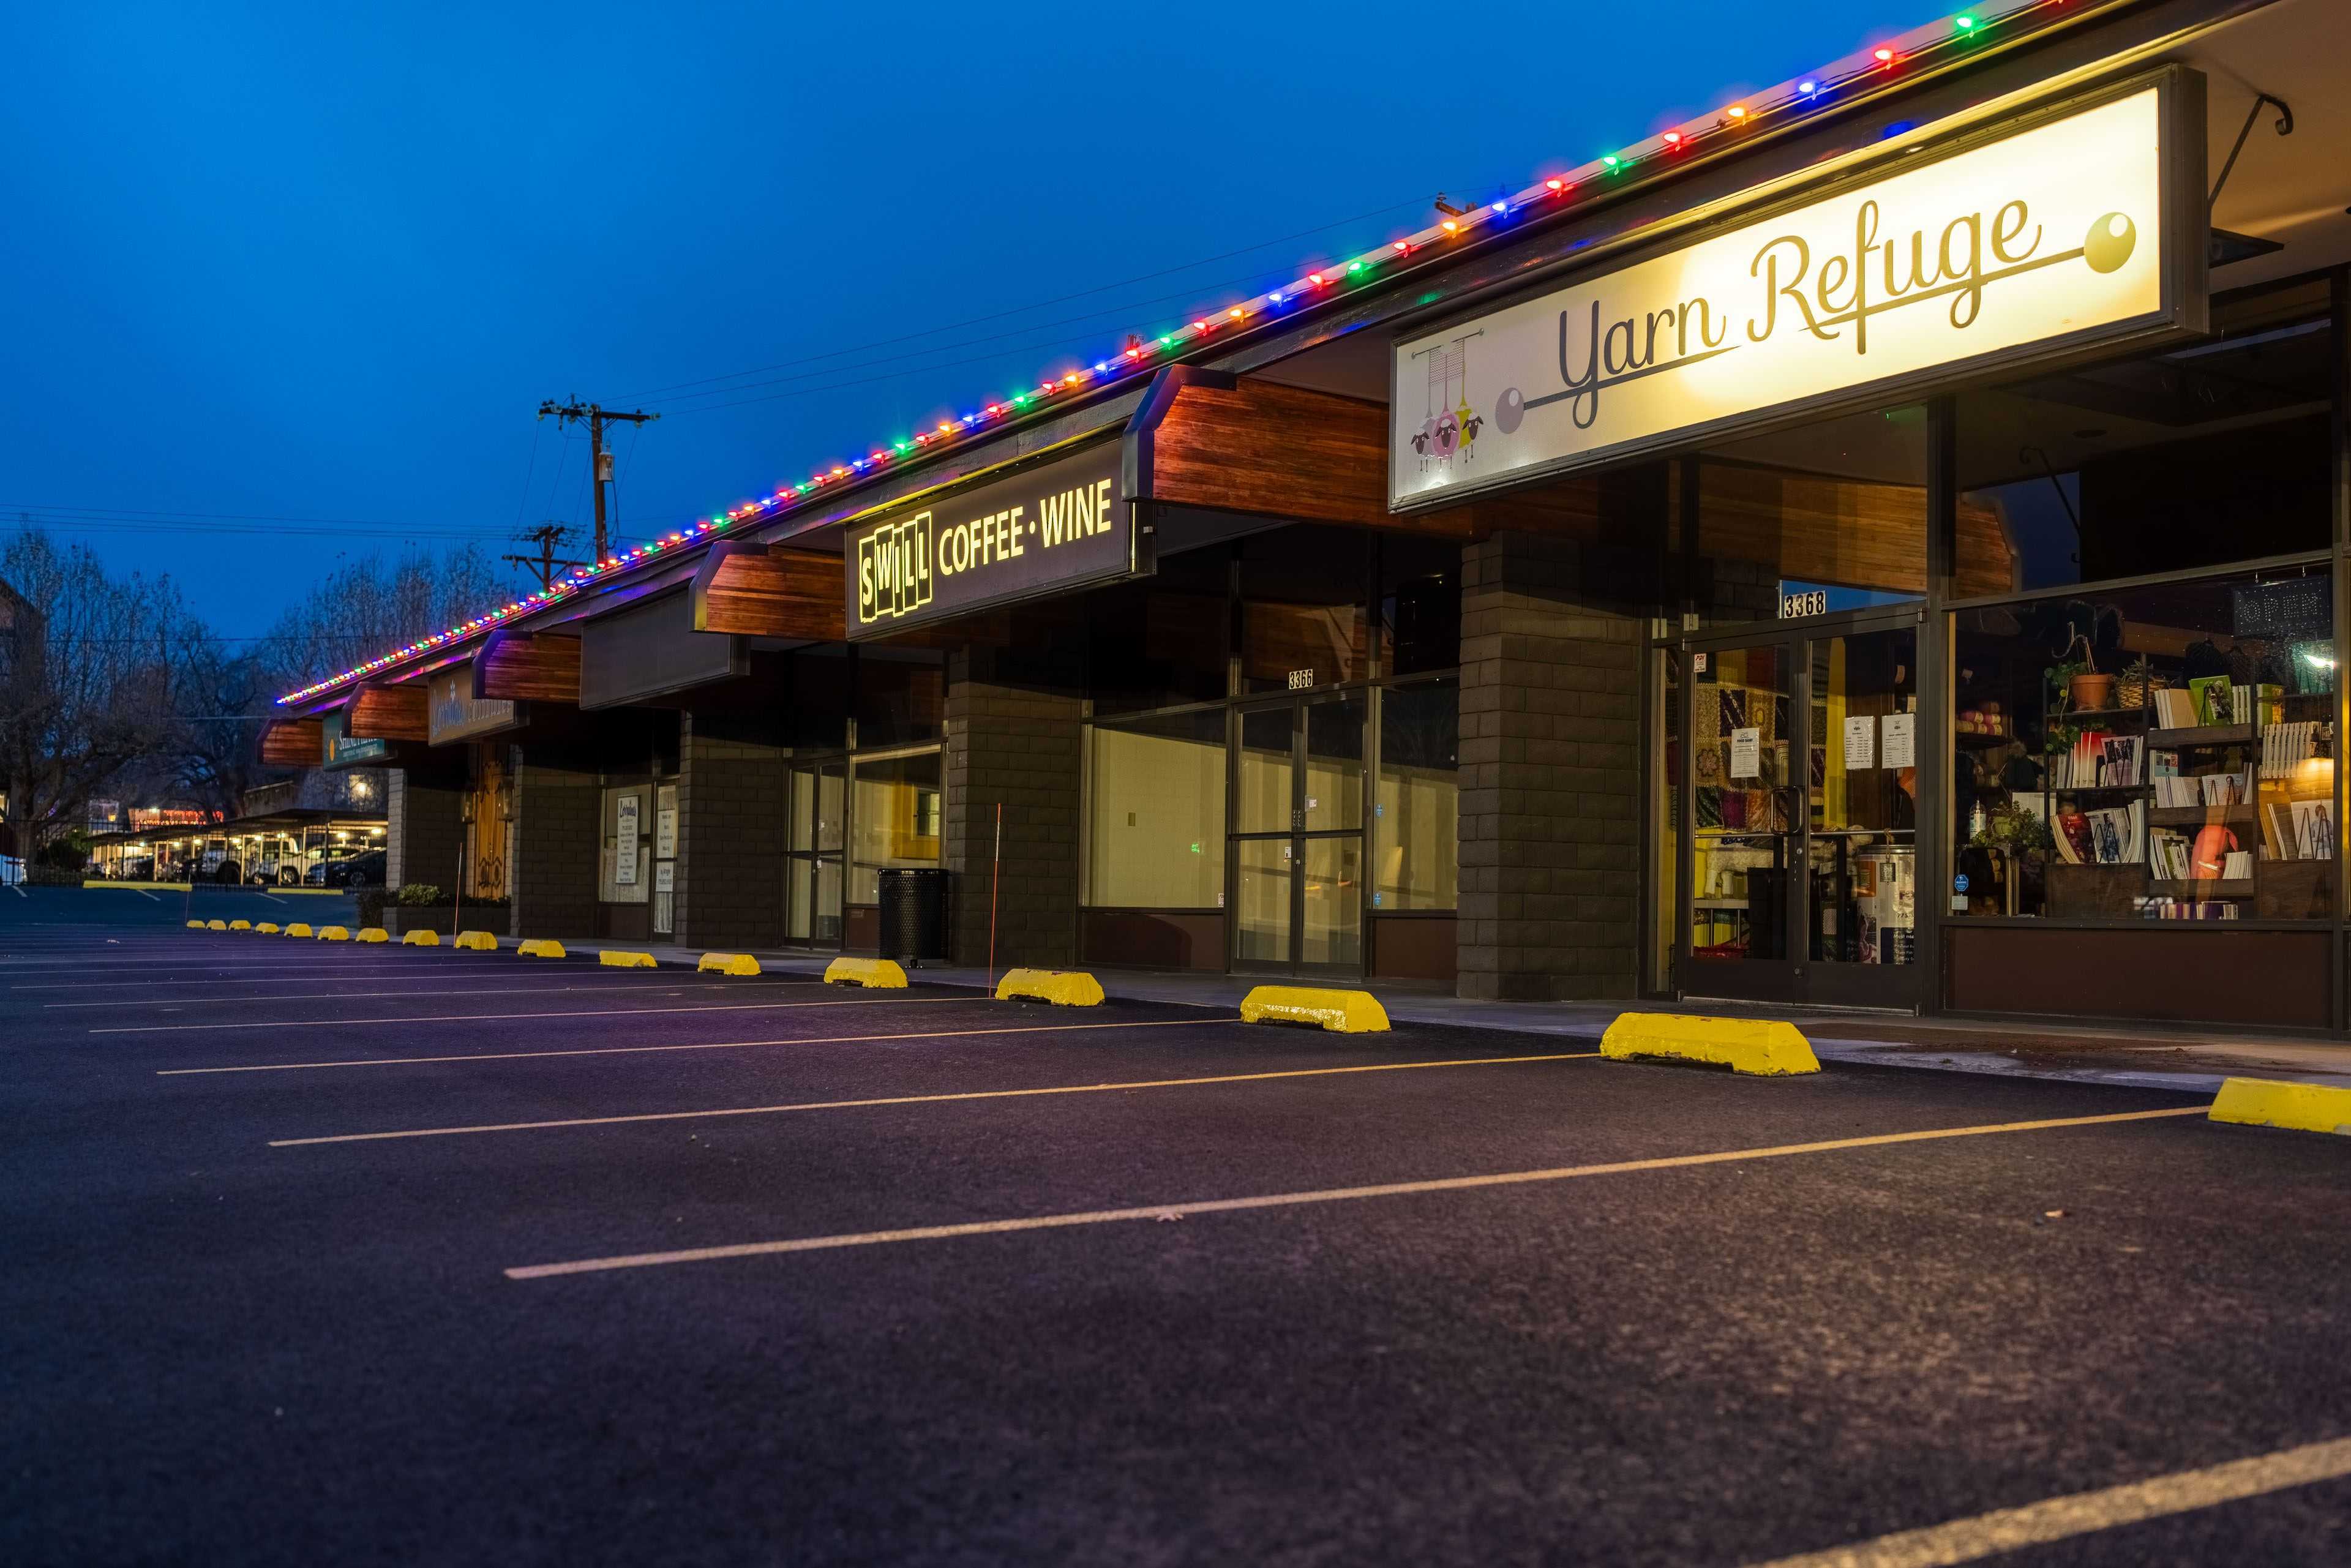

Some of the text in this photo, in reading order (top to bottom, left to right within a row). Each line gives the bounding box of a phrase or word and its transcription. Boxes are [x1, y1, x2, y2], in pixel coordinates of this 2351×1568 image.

[1559, 199, 2042, 429] Yarn Refuge
[861, 478, 1111, 606] SWILL COFFEE WINE
[1786, 591, 1824, 617] 3368
[2243, 591, 2317, 622] OPEN
[1290, 670, 1311, 688] 3366
